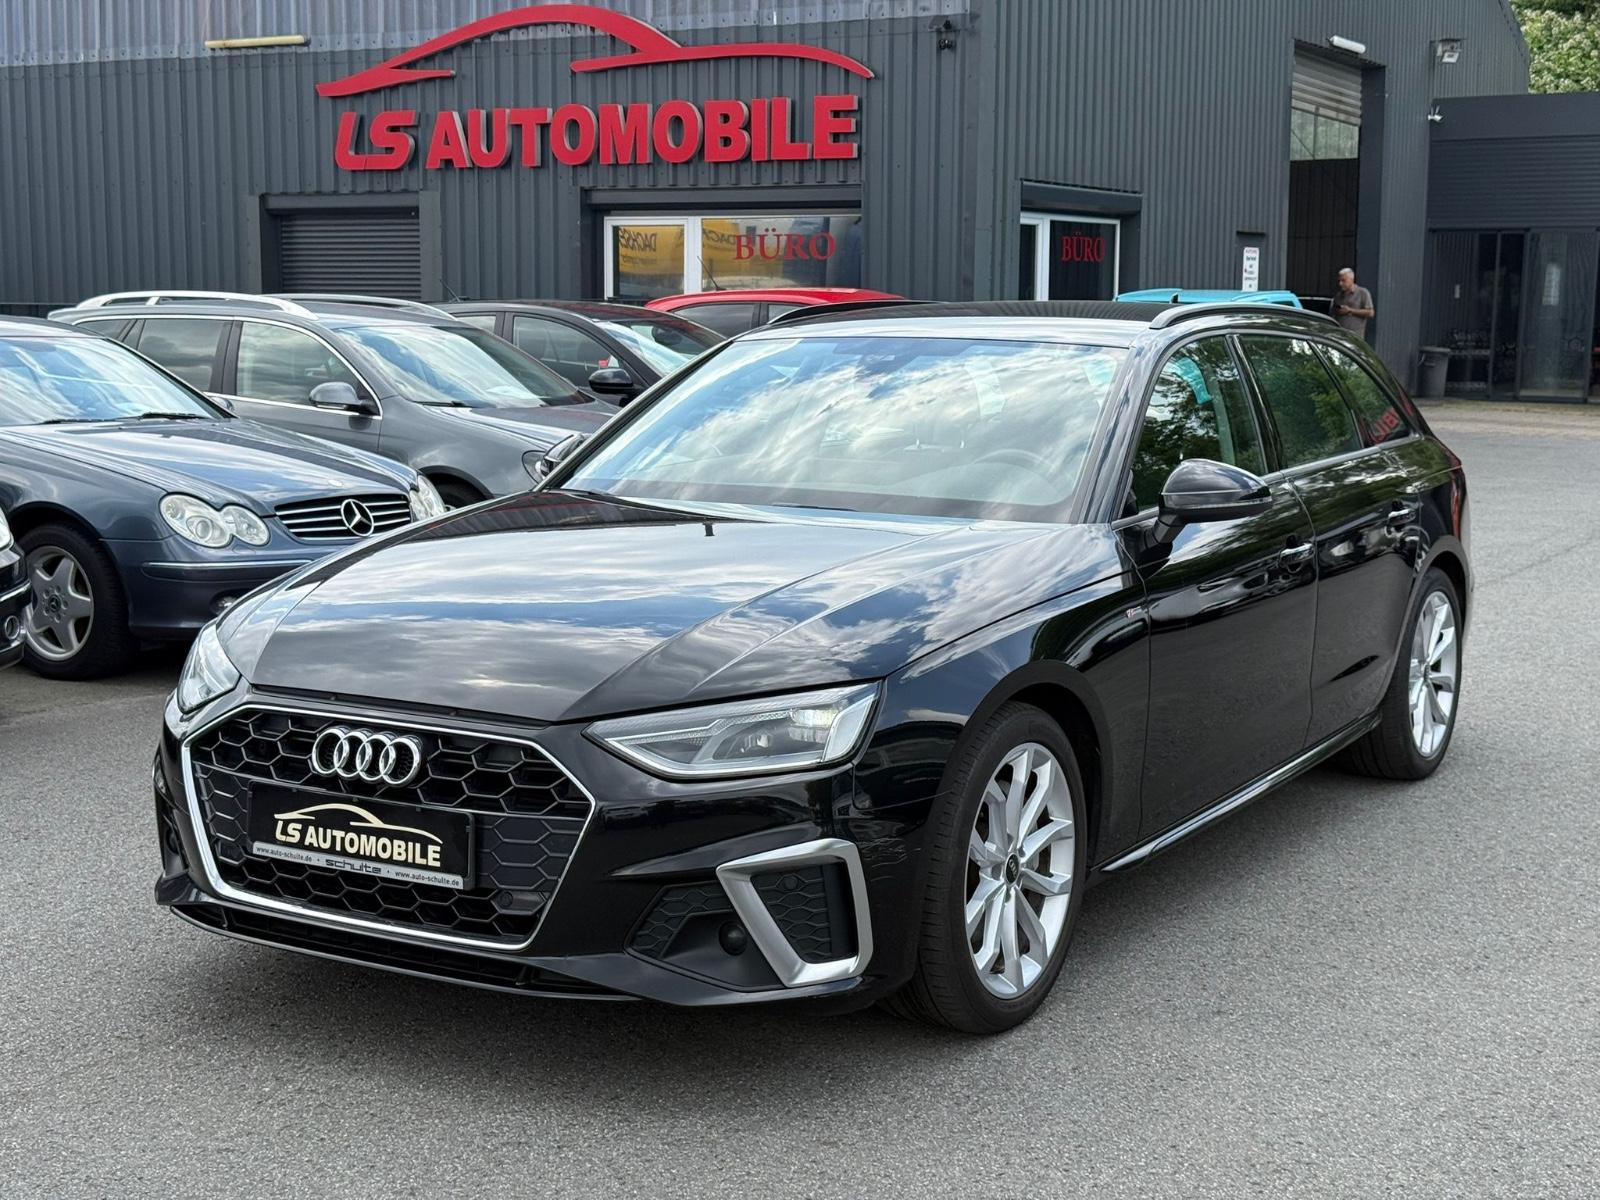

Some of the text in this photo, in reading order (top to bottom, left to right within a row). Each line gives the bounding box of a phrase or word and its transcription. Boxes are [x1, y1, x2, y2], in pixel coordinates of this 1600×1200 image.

[334, 95, 859, 171] LS AUTOMOBILE
[735, 228, 835, 260] BÜRO
[1061, 231, 1105, 263] BÜRO
[275, 820, 441, 867] LS AUTOMOBILE
[256, 847, 460, 887] www.auto-schulte.de schulte www.auto-schulte.de
